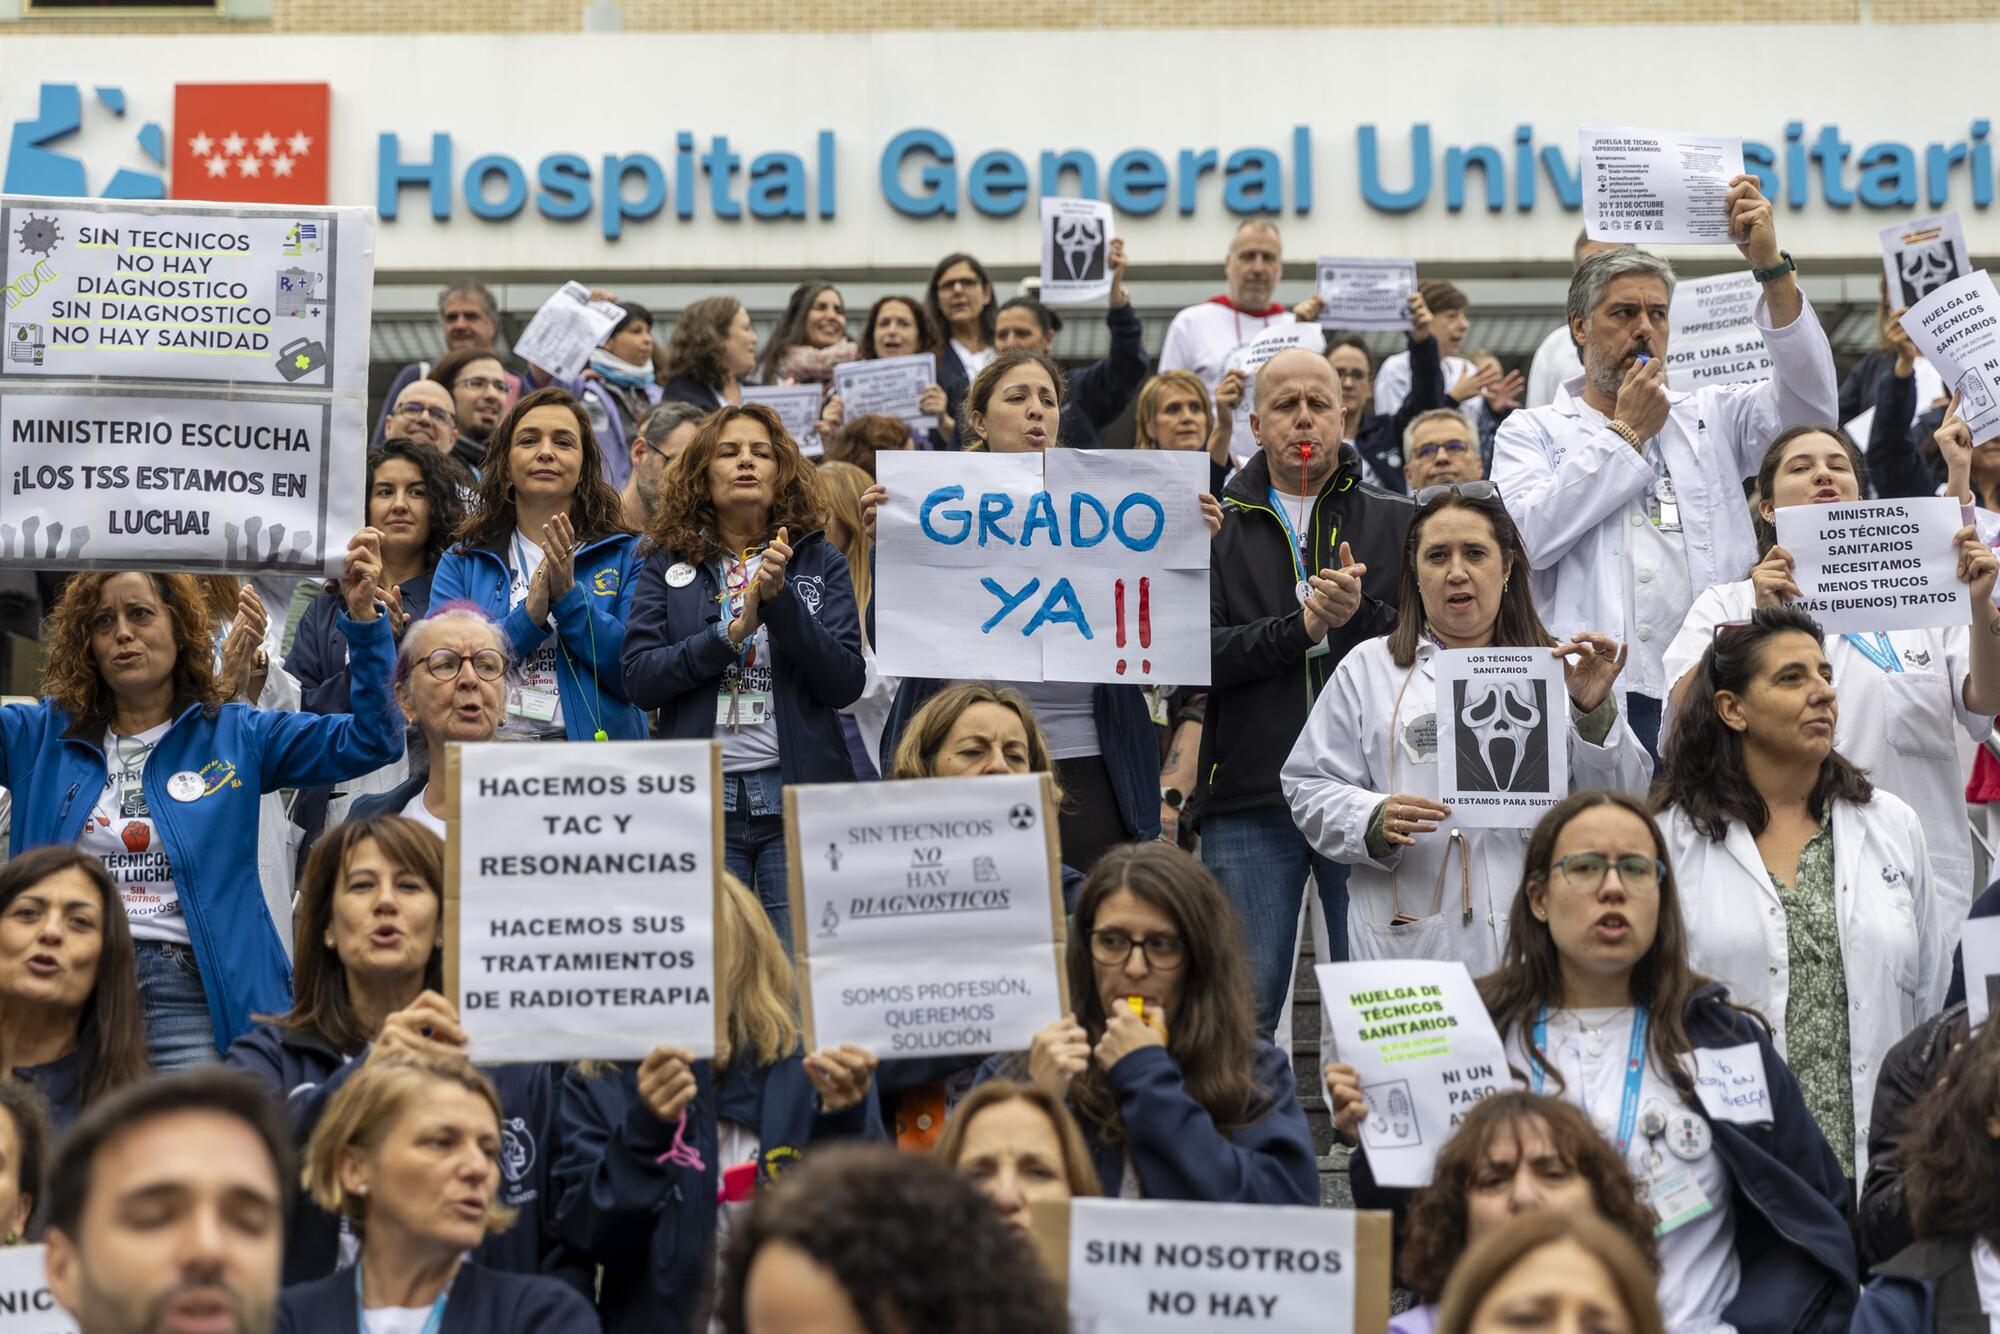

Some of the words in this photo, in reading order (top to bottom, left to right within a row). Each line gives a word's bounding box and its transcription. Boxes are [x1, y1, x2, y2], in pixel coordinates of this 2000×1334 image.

[378, 129, 836, 241] Hospital
[880, 125, 1312, 216] General
[78, 227, 119, 246] SIN
[128, 229, 250, 251] TECNICOS
[117, 254, 154, 273] NO
[163, 256, 213, 275] HAY
[77, 276, 248, 300] DIAGNOSTICO
[51, 300, 91, 319] SIN
[101, 303, 272, 326] DIAGNOSTICO
[1922, 297, 1964, 327] HUELGA
[1964, 290, 1980, 301] DE
[1931, 304, 1984, 338] TÉCNICOS
[52, 326, 89, 345] NO
[99, 327, 150, 347] HAY
[157, 329, 269, 351] SANIDAD
[1936, 316, 1997, 354] SANITARIOS
[1667, 352, 1695, 365] POR
[1700, 346, 1731, 359] UNA
[1984, 358, 1999, 372] NI
[12, 420, 172, 445] MINISTERIO
[181, 423, 311, 452] ESCUCHA
[13, 465, 73, 495] ¡LOS
[81, 466, 129, 489] TSS
[136, 466, 264, 495] ESTAMOS
[272, 473, 307, 497] EN
[108, 510, 210, 535] LUCHA!
[920, 484, 1165, 552] GRADO
[1828, 506, 1908, 521] MINISTRAS,
[1820, 528, 1846, 540] LOS
[1850, 524, 1920, 538] TÉCNICOS
[1828, 540, 1913, 556] SANITARIOS
[1822, 558, 1922, 575] NECESITAMOS
[1818, 580, 1868, 593] MENOS
[1871, 576, 1928, 589] TRUCOS
[1796, 598, 1828, 611] MÁS
[1831, 594, 1898, 612] (BUENOS)
[1900, 592, 1956, 606] TRATOS
[1488, 654, 1532, 662] TÉCNICOS
[1473, 666, 1528, 674] SANITARIOS
[479, 775, 627, 797] HACEMOS
[637, 774, 696, 794] SUS
[1503, 798, 1527, 806] PARA
[543, 815, 602, 835] TAC
[613, 814, 632, 834] Y
[848, 826, 883, 845] SIN
[889, 819, 993, 843] TECNICOS
[480, 852, 697, 877] RESONANCIAS
[911, 847, 942, 865] NO
[130, 886, 146, 894] SIN
[906, 869, 949, 889] HAY
[850, 888, 1012, 916] DIAGNOSTICOS
[490, 917, 622, 937] HACEMOS
[632, 916, 685, 934] SUS
[481, 950, 695, 973] TRATAMIENTOS
[465, 991, 500, 1010] DE
[510, 987, 711, 1009] RADIOTERAPIA
[842, 986, 914, 1006] SOMOS
[918, 977, 1032, 1002] PROFESIÓN,
[1350, 987, 1418, 1005] HUELGA
[1421, 985, 1442, 997] DE
[884, 1004, 995, 1028] QUEREMOS
[1360, 1001, 1444, 1022] TÉCNICOS
[892, 1028, 992, 1051] SOLUCIÓN
[1358, 1016, 1458, 1041] SANITARIOS
[1442, 1070, 1461, 1085] NI
[1466, 1064, 1494, 1080] UN
[1448, 1084, 1497, 1104] PASO
[1086, 1240, 1142, 1265] SIN
[1155, 1243, 1343, 1274] NOSOTROS
[1147, 1290, 1196, 1316] NO
[1209, 1293, 1278, 1318] HAY
